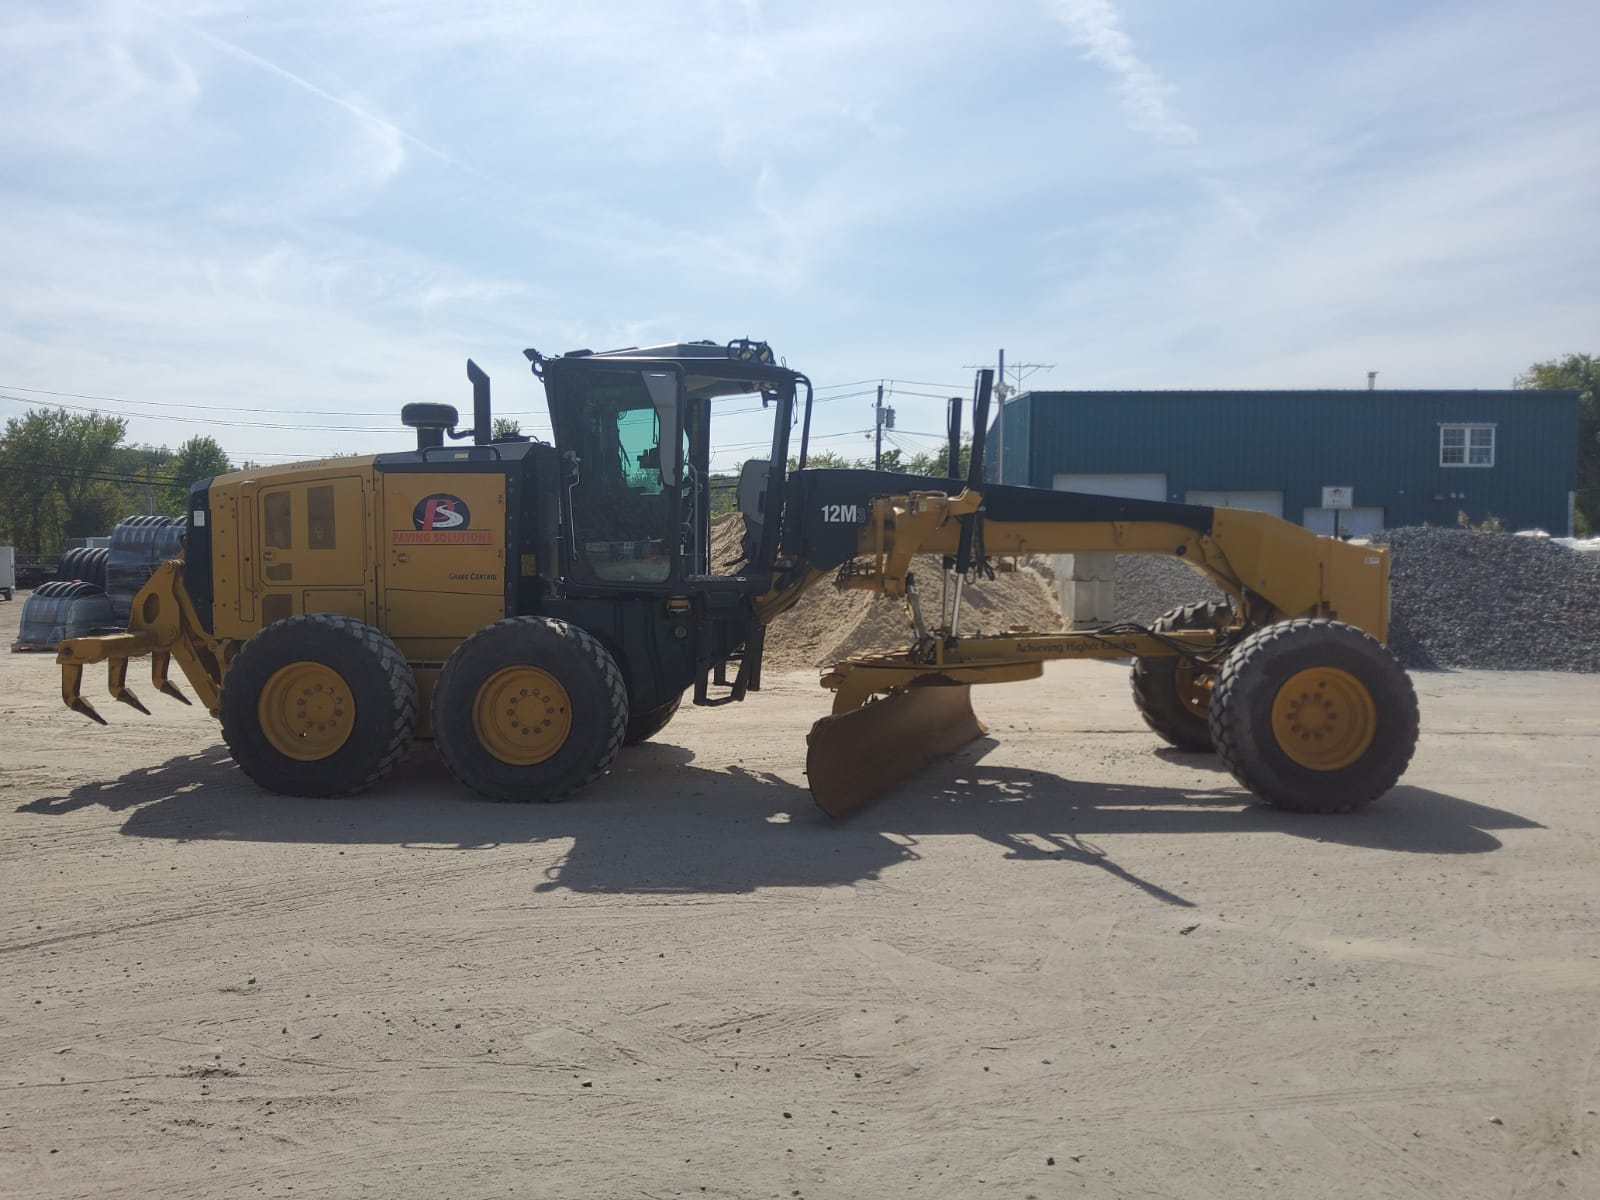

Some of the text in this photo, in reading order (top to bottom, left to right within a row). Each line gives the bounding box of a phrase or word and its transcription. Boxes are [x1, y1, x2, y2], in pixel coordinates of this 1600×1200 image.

[392, 532, 493, 544] PAVING SOLUTIONS
[1016, 642, 1063, 654] Achieving
[1066, 640, 1099, 653] Higher
